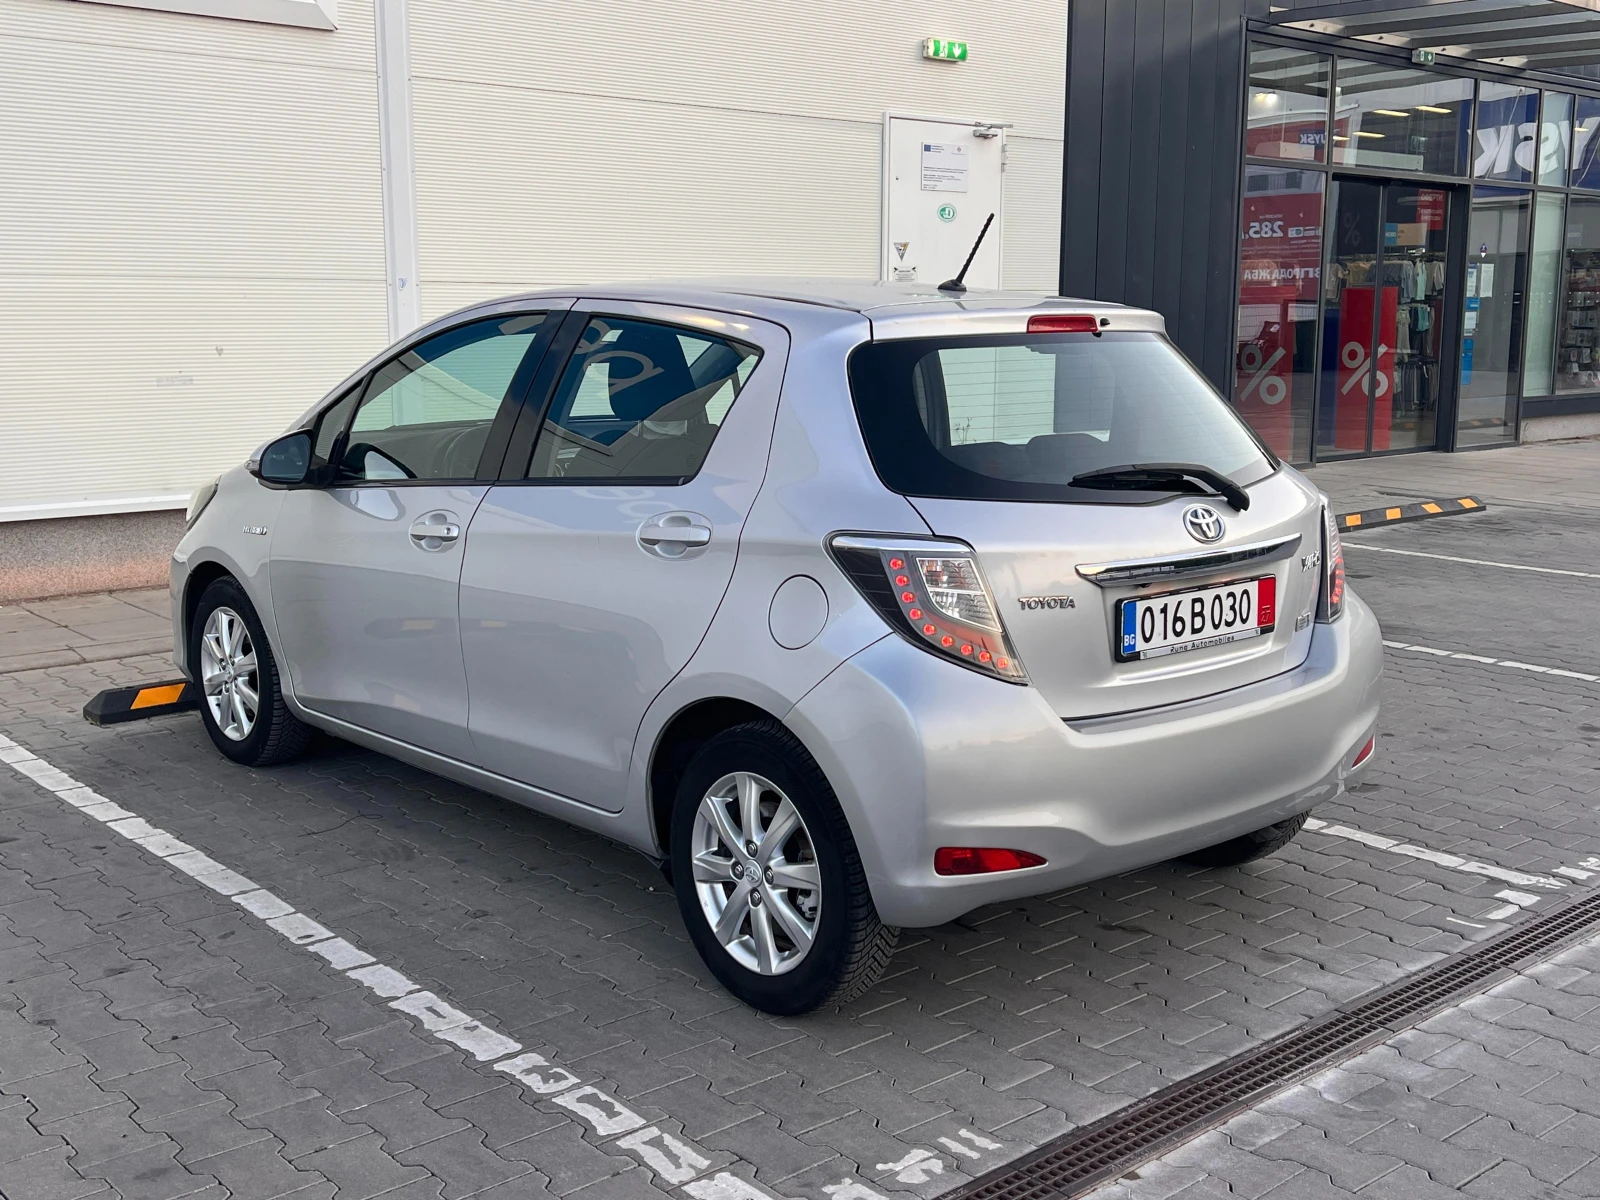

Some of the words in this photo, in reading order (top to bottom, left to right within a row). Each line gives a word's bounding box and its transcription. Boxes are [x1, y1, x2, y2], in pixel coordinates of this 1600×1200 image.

[1018, 596, 1076, 610] TOYOTA
[1124, 634, 1136, 646] BG
[1190, 634, 1235, 649] Automobiles
